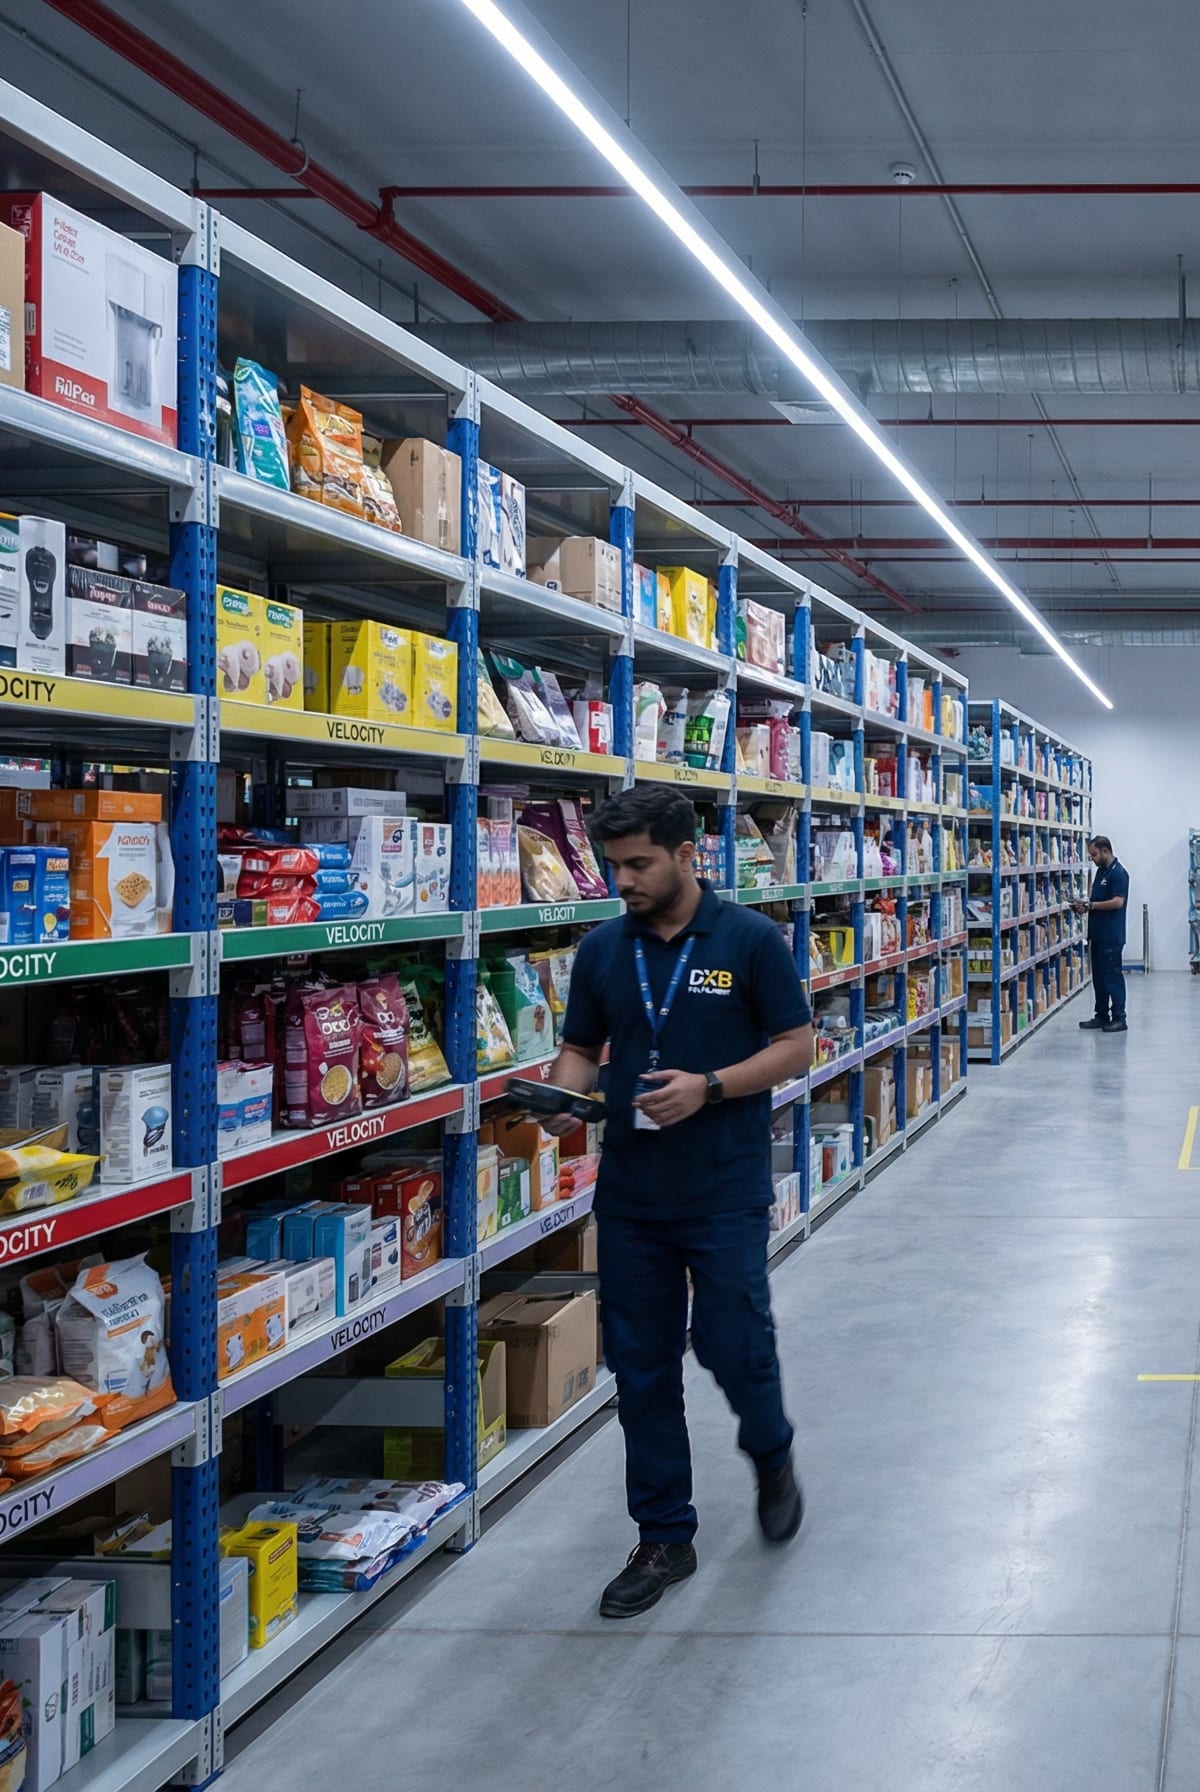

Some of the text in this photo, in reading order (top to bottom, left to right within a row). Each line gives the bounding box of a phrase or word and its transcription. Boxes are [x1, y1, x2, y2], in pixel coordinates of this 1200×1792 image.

[327, 720, 385, 744] VELOCITY
[326, 922, 386, 944] VELOCITY
[689, 969, 733, 988] DXB
[327, 1115, 386, 1149] VELOCITY
[331, 1307, 387, 1350] VELOCITY
